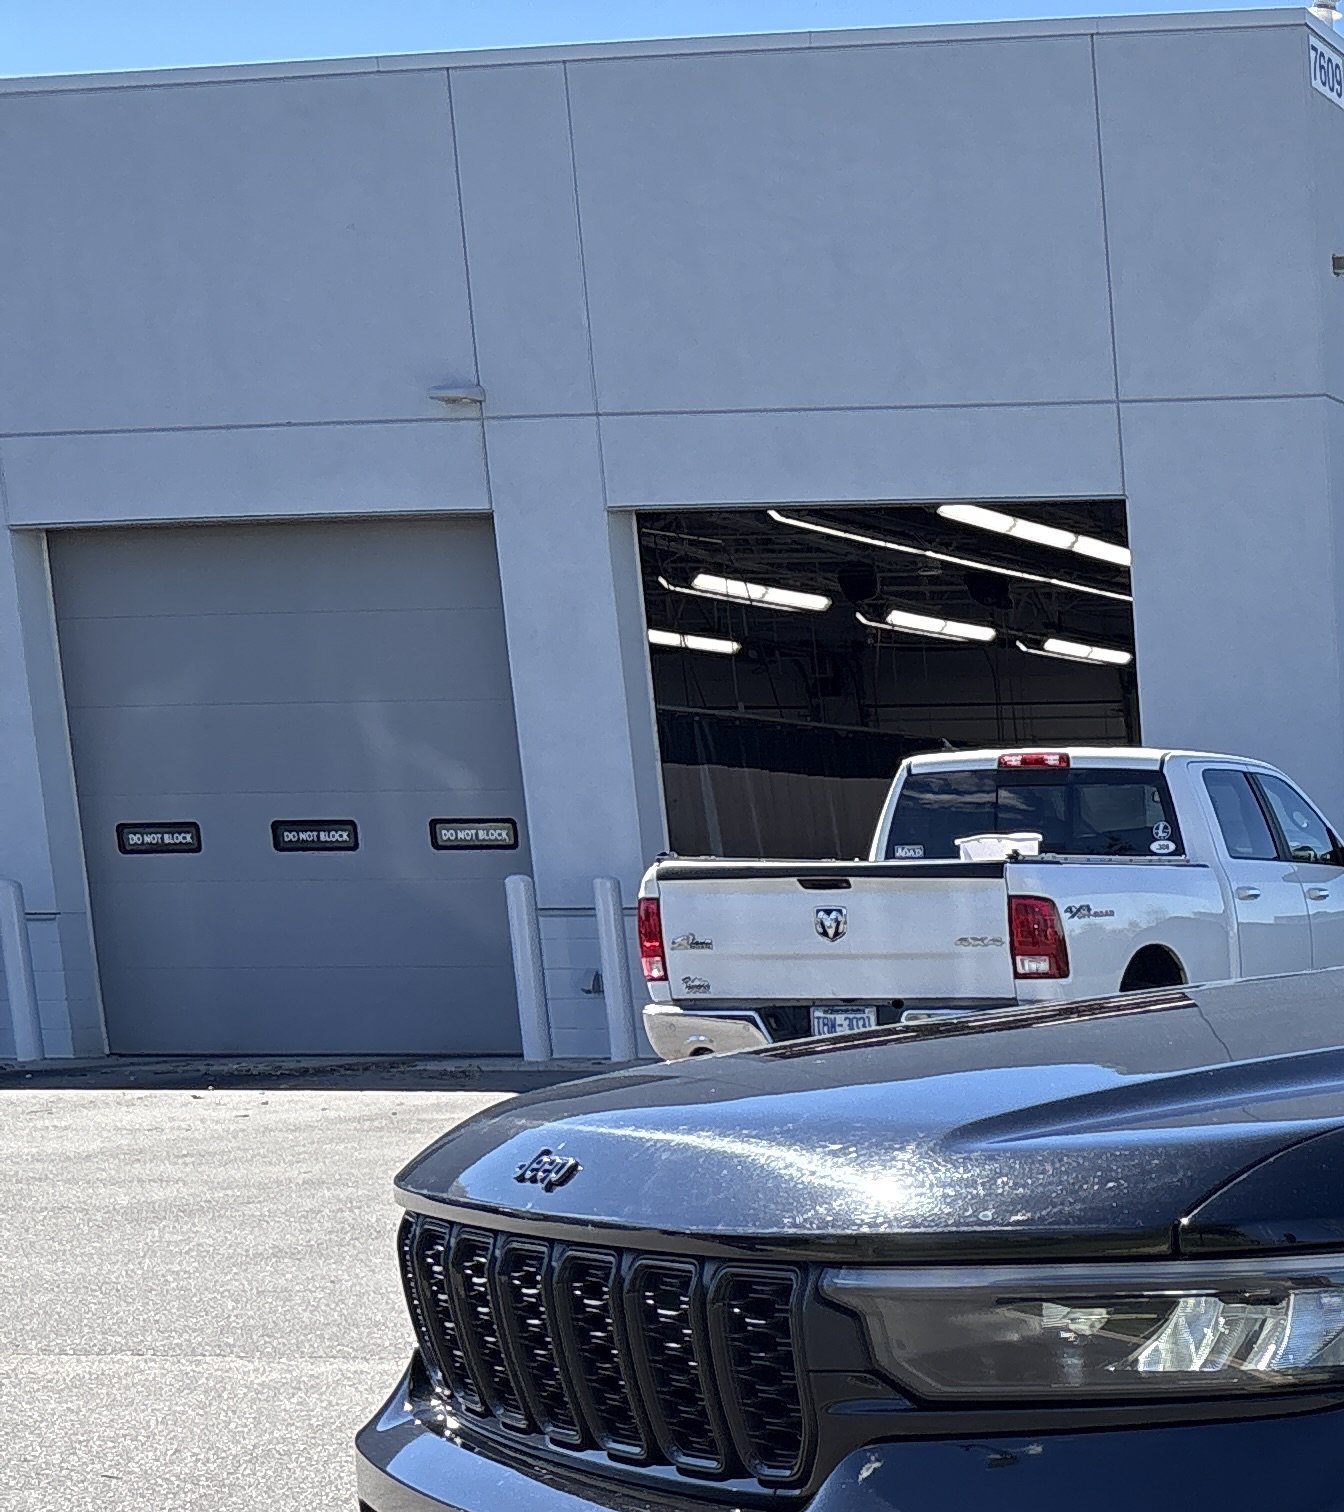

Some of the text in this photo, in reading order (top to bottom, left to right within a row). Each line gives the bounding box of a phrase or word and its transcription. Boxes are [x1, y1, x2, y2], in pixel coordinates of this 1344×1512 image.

[1311, 44, 1342, 98] 7609
[128, 833, 193, 845] DO NOT BLOCK
[283, 830, 350, 842] DO NOT BLOCK
[441, 829, 509, 842] DO NOT BLOCK
[513, 1148, 580, 1193] Jeep
